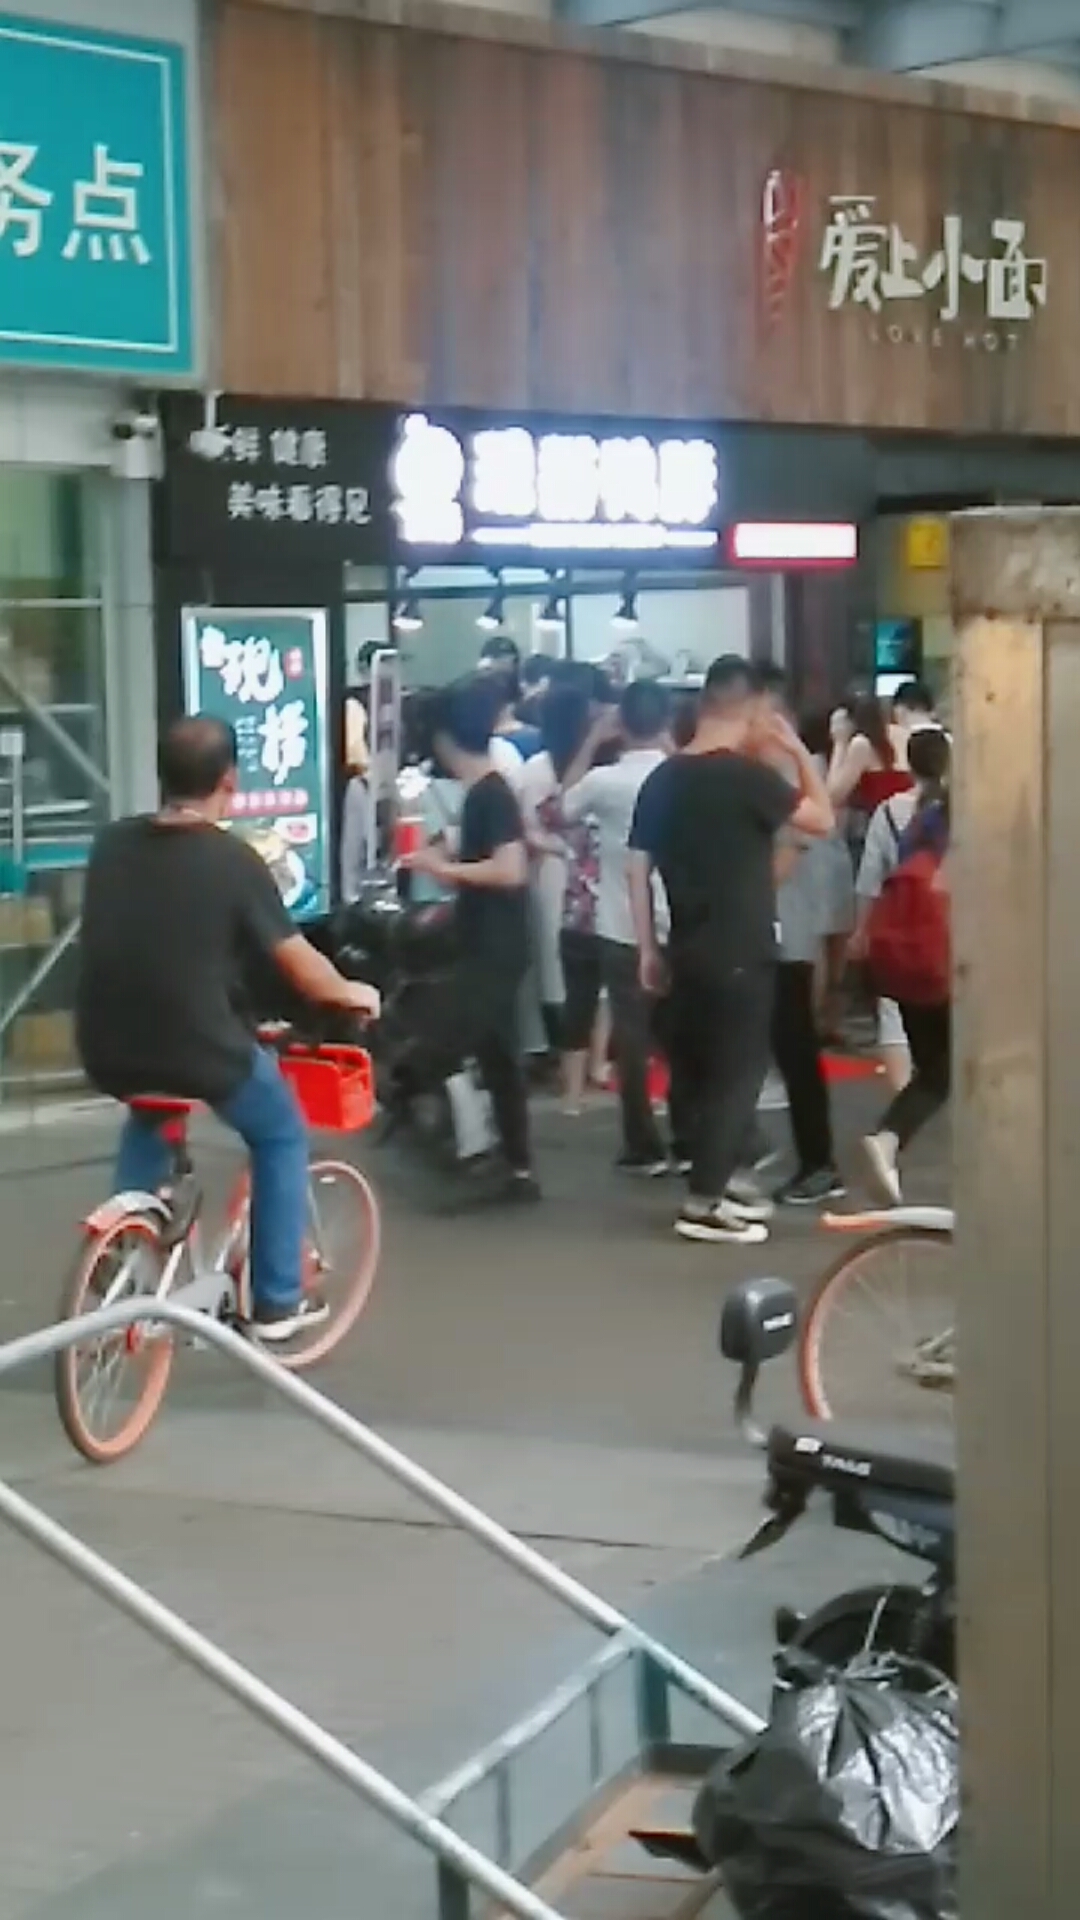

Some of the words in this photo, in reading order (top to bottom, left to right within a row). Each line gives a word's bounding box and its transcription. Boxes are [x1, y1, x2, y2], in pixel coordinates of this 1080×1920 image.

[0, 141, 152, 265] 务点
[819, 195, 1048, 321] 爱上小面
[270, 427, 327, 468] 健康
[228, 480, 372, 525] 美味看得见
